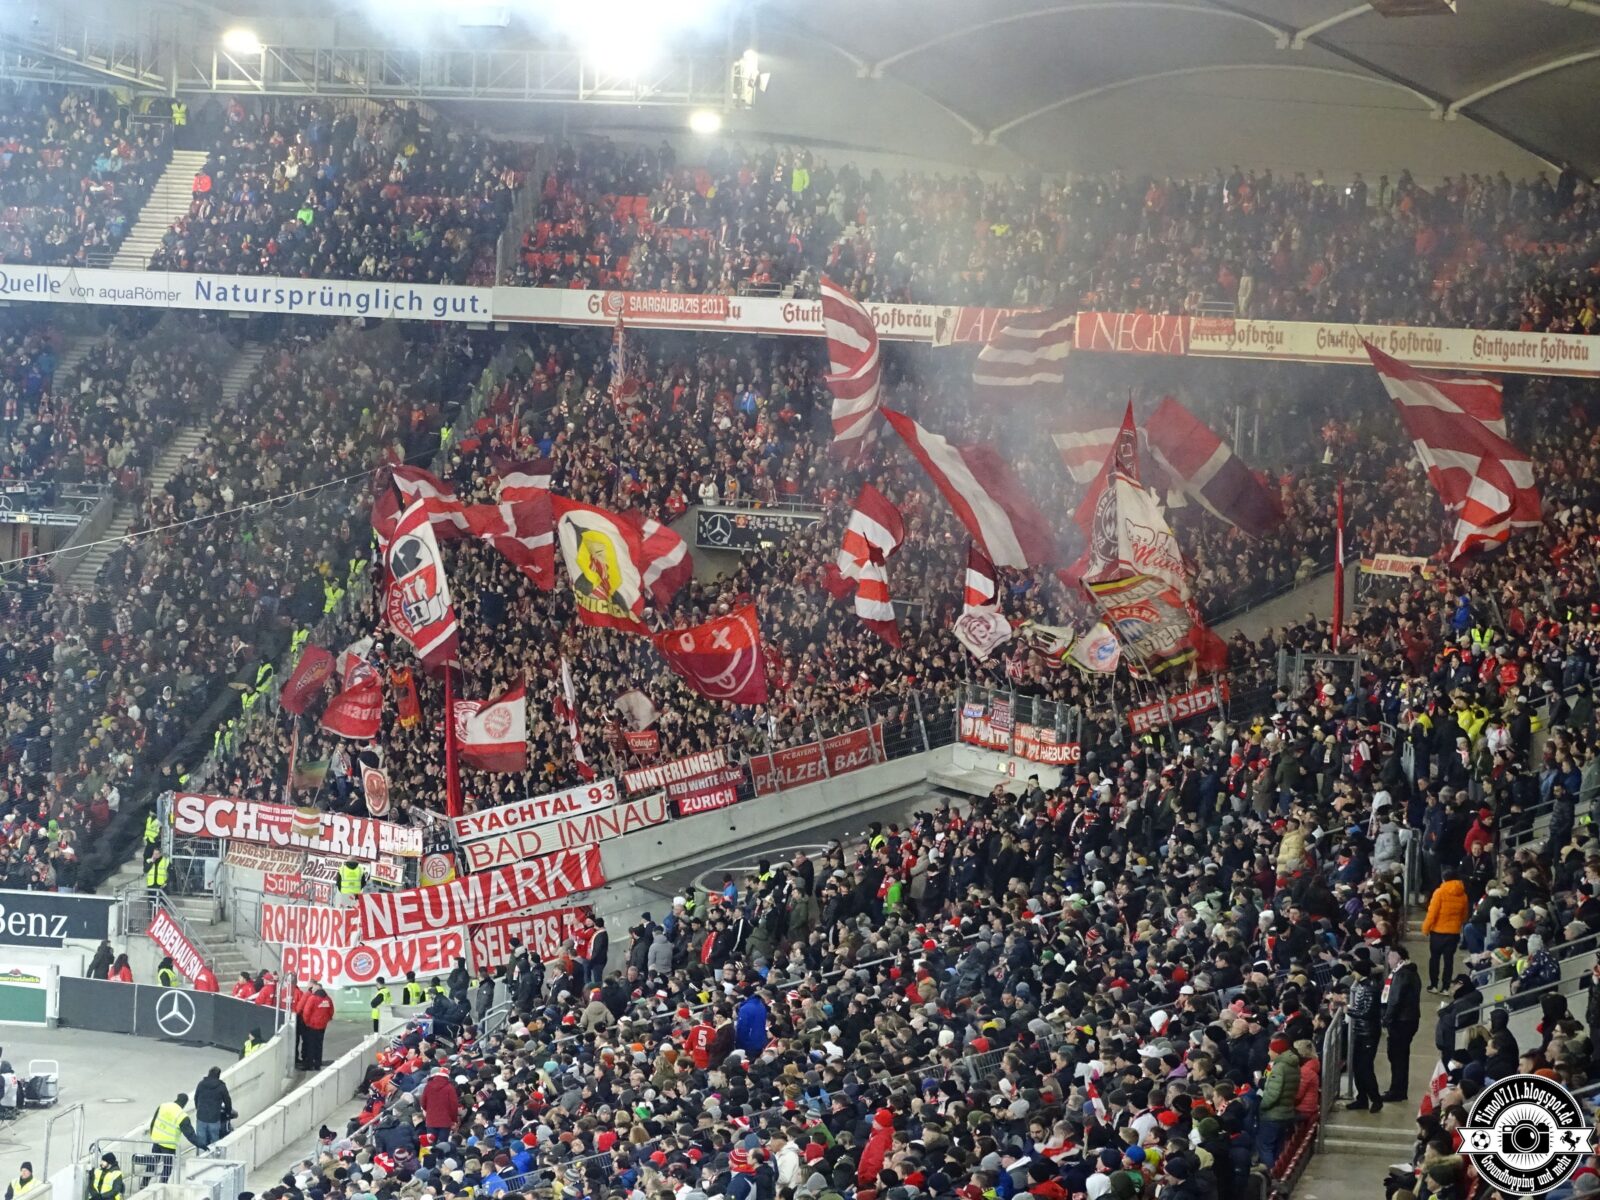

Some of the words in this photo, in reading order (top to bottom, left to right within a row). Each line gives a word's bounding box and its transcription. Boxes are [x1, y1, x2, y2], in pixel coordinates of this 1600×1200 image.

[69, 287, 95, 297] von
[99, 284, 181, 302] aquaRömer
[194, 281, 423, 314] Natursprünglich
[432, 295, 488, 317] gut.
[629, 296, 700, 313] SAARGAUBAZIS
[701, 299, 724, 314] 2011
[870, 306, 932, 328] Hofbräu
[1090, 312, 1184, 354] NEGRA
[1316, 326, 1387, 355] Stuttgarter
[1389, 332, 1442, 354] Hofbräu
[1473, 335, 1537, 360] Stuttgarter
[1540, 341, 1590, 361] Hofbräu
[822, 737, 851, 751] ANCLUB
[624, 749, 726, 792] WINTERLINGEN
[669, 783, 687, 795] RED
[688, 774, 719, 791] WHITE
[456, 797, 582, 836] EYACHTAL
[587, 783, 616, 803] 93
[683, 788, 734, 812] ZURICH
[174, 796, 378, 860] SCHICERIA
[467, 829, 542, 868] BAD
[558, 797, 666, 847] IMNAU
[259, 861, 275, 873] BEI
[362, 844, 595, 938] NEUMARKT
[262, 904, 358, 947] ROHRDORF
[473, 916, 560, 967] SELTERS
[698, 1030, 708, 1046] 5
